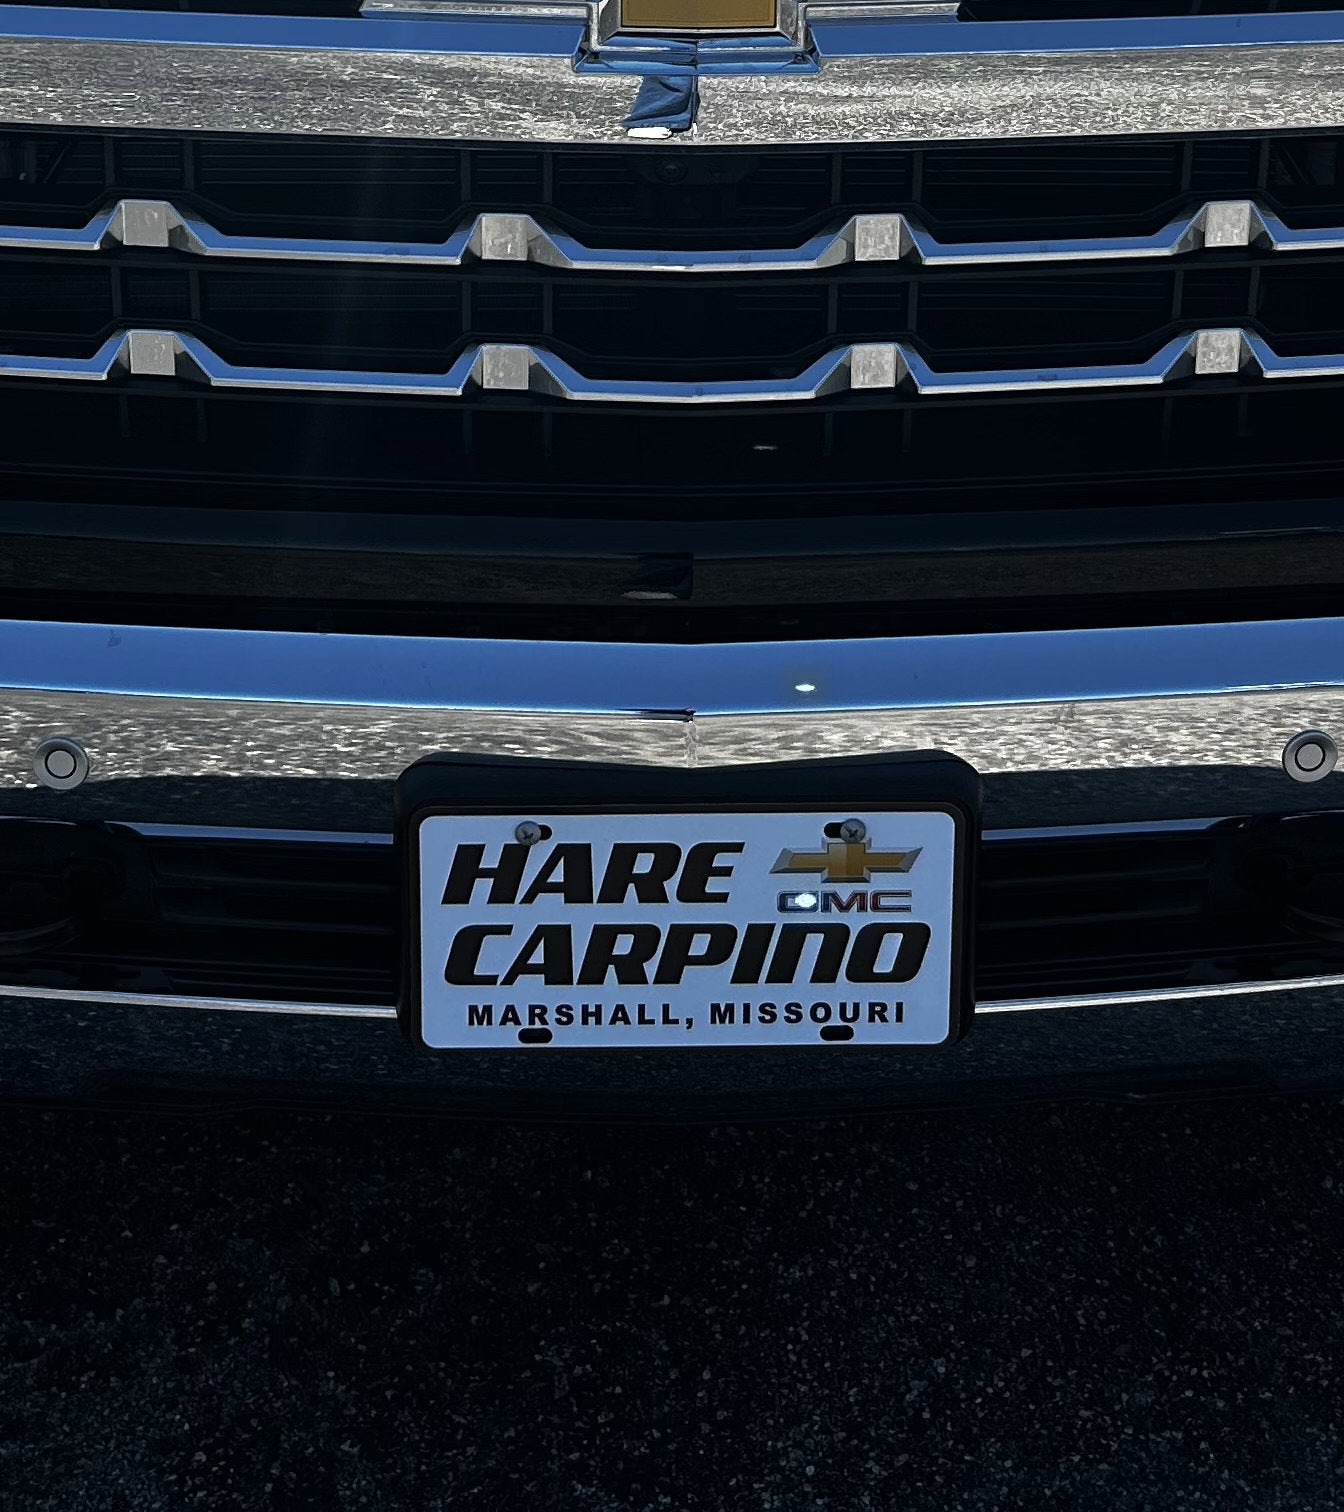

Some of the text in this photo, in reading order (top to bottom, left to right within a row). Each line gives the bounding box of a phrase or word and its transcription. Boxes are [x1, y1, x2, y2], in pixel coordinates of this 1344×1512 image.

[440, 841, 746, 906] HARE
[444, 921, 932, 986] CARPINO
[467, 999, 904, 1030] MARSHALL, MISSOURI
